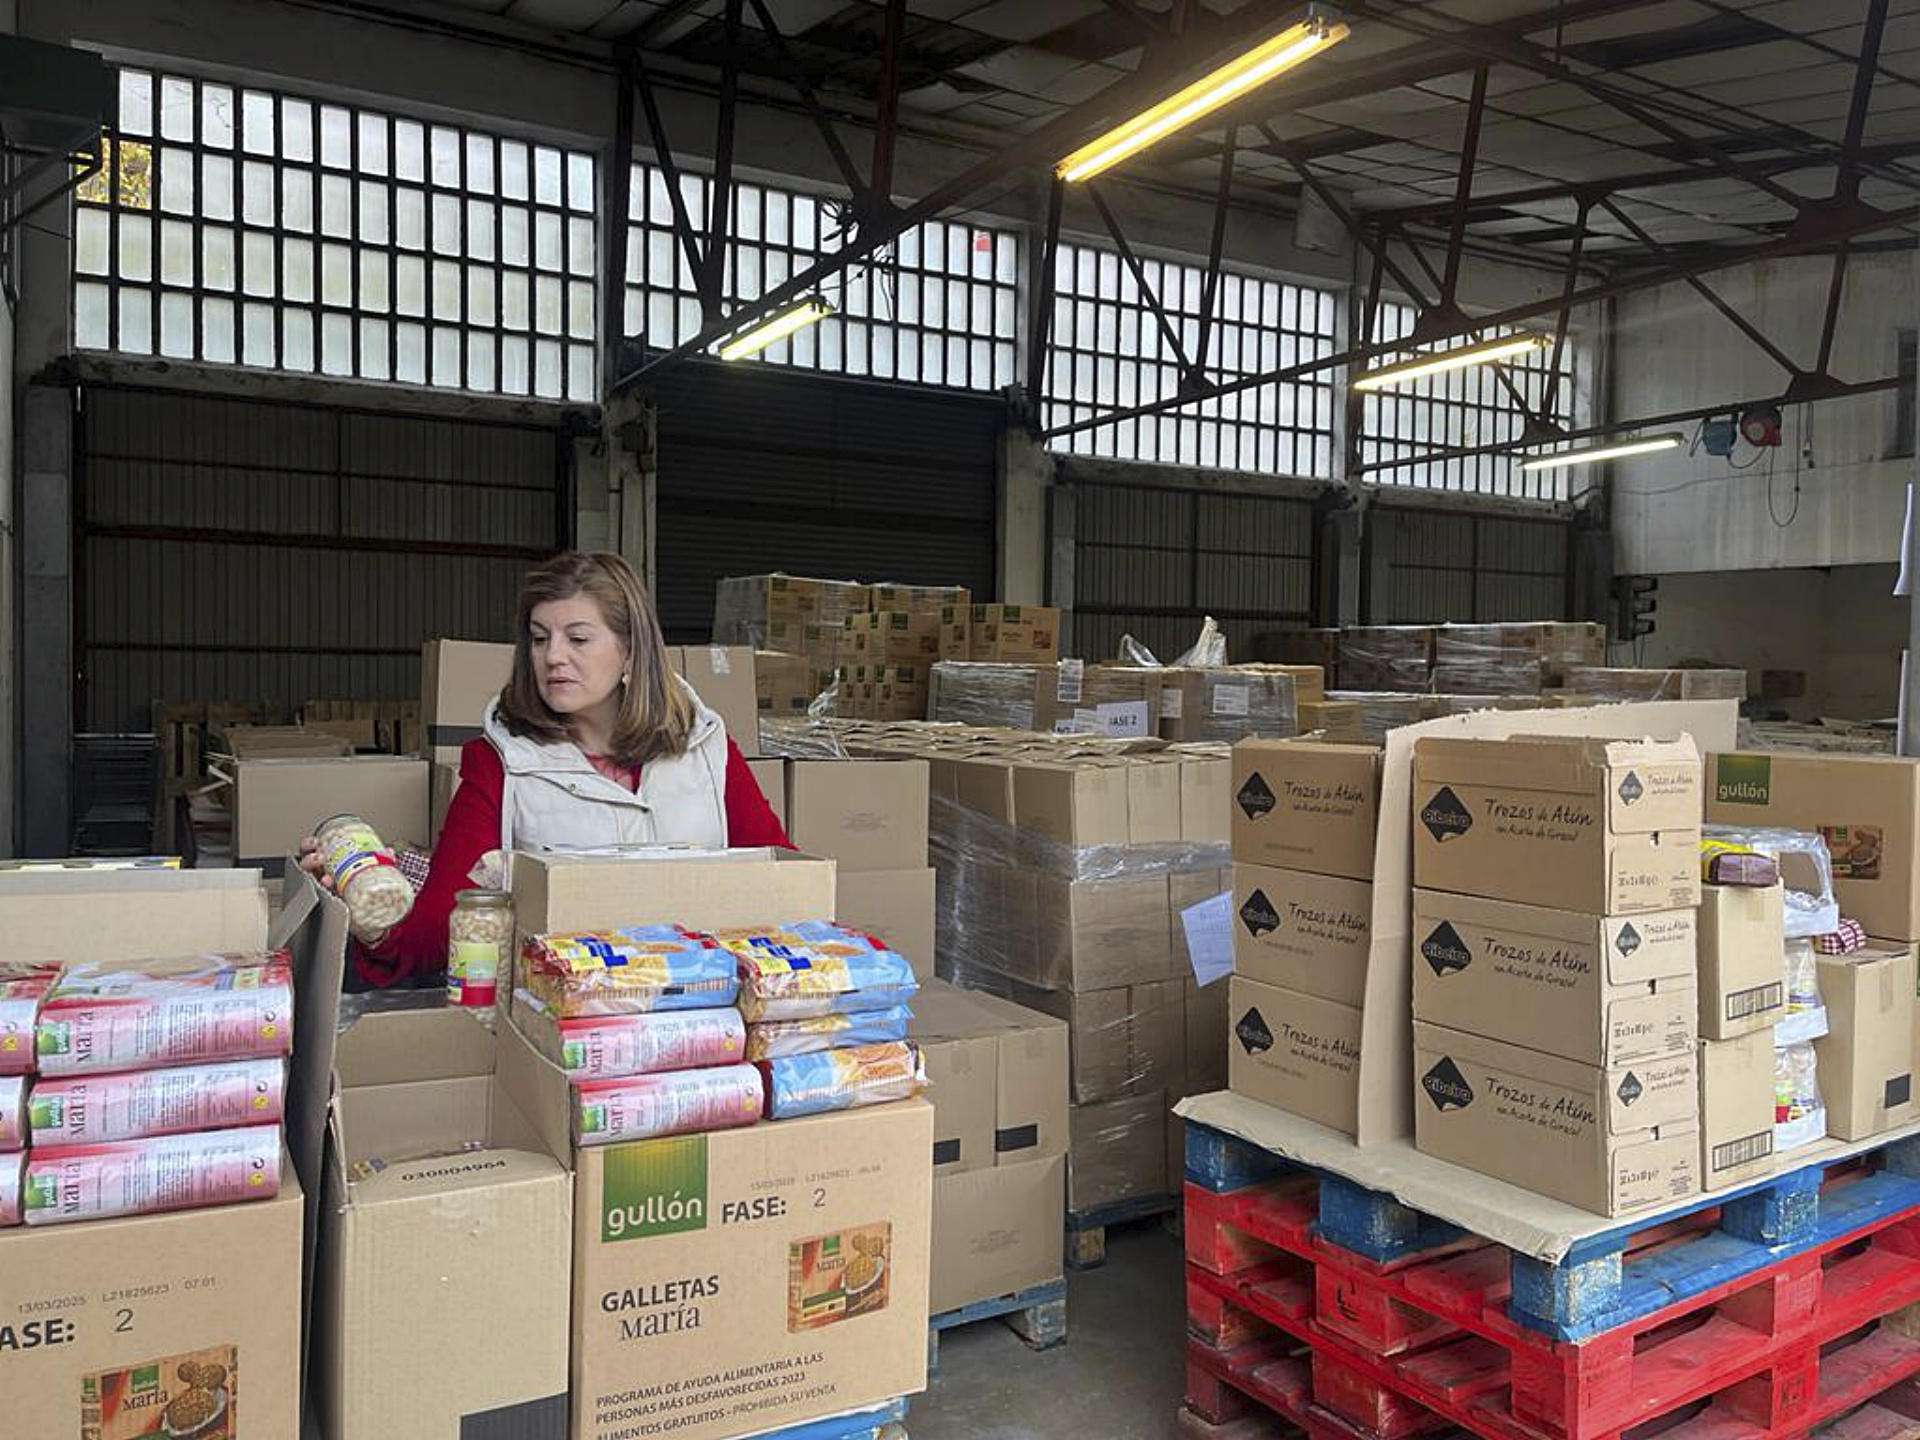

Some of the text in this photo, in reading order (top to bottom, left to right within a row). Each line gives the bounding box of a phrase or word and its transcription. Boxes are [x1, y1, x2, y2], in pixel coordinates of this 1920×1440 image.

[1284, 780, 1321, 799] Trozos
[1718, 781, 1768, 800] gullón
[1485, 798, 1534, 820] Trozos
[1551, 805, 1593, 826] Atún
[1289, 902, 1326, 923] Trozos
[1337, 911, 1368, 932] Atún
[1483, 936, 1532, 962] Trozos
[1549, 949, 1592, 974] Atún
[1283, 1023, 1320, 1048] Trozos
[1485, 1077, 1537, 1106] Trozos
[1552, 1096, 1597, 1124] Atún
[608, 1190, 702, 1236] gullón
[721, 1187, 827, 1224] FASE: 2
[601, 1275, 720, 1313] GALLETAS
[114, 1308, 135, 1333] 2
[619, 1303, 701, 1341] María
[595, 1371, 806, 1425] PERSONAS MÁS DESFAVORECIDAS 2023
[596, 1351, 825, 1409] PROGRAMA DE AYUDA ALIMENTARIA A LAS
[663, 1407, 725, 1431] GRATUITOS
